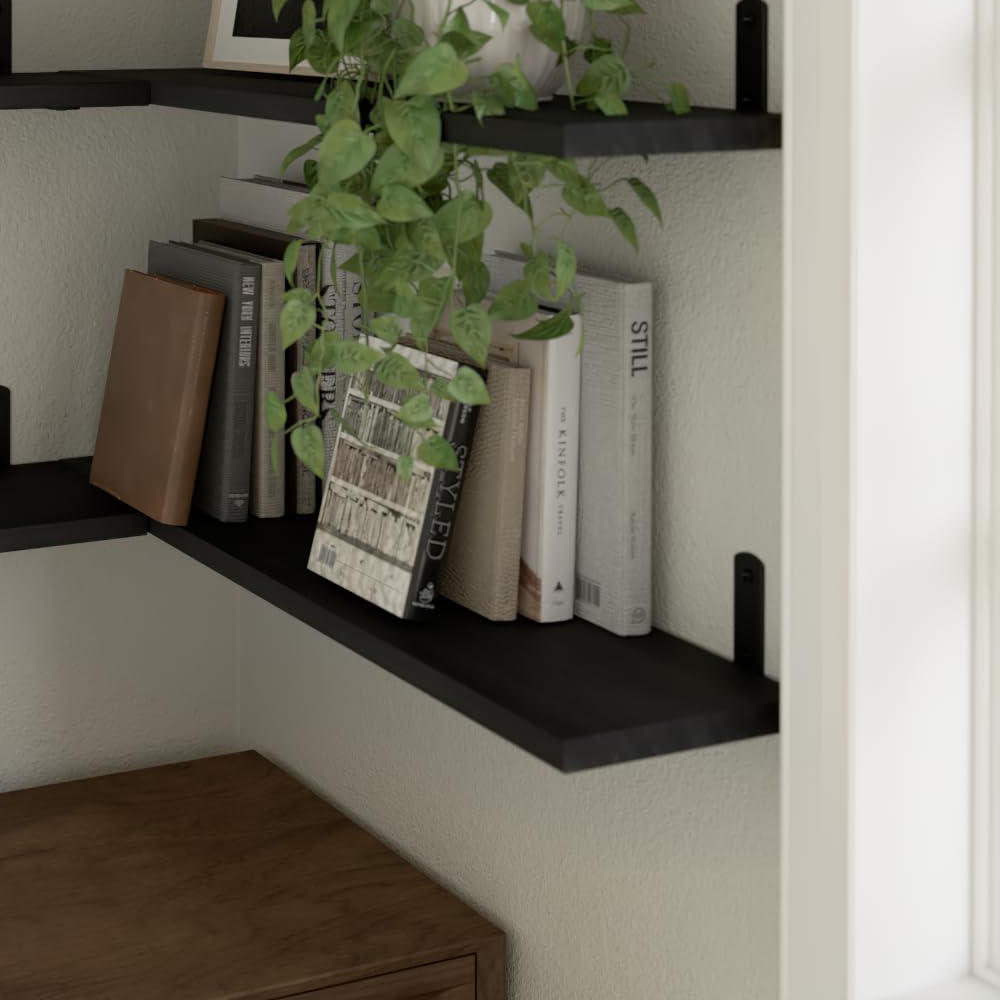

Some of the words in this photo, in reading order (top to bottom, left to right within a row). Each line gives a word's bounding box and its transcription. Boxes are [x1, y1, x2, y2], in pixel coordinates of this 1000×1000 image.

[242, 276, 255, 295] NEW
[241, 301, 254, 320] YORK
[238, 326, 252, 367] INTERIORS
[631, 320, 649, 377] STILL
[556, 429, 568, 499] KINFOLK
